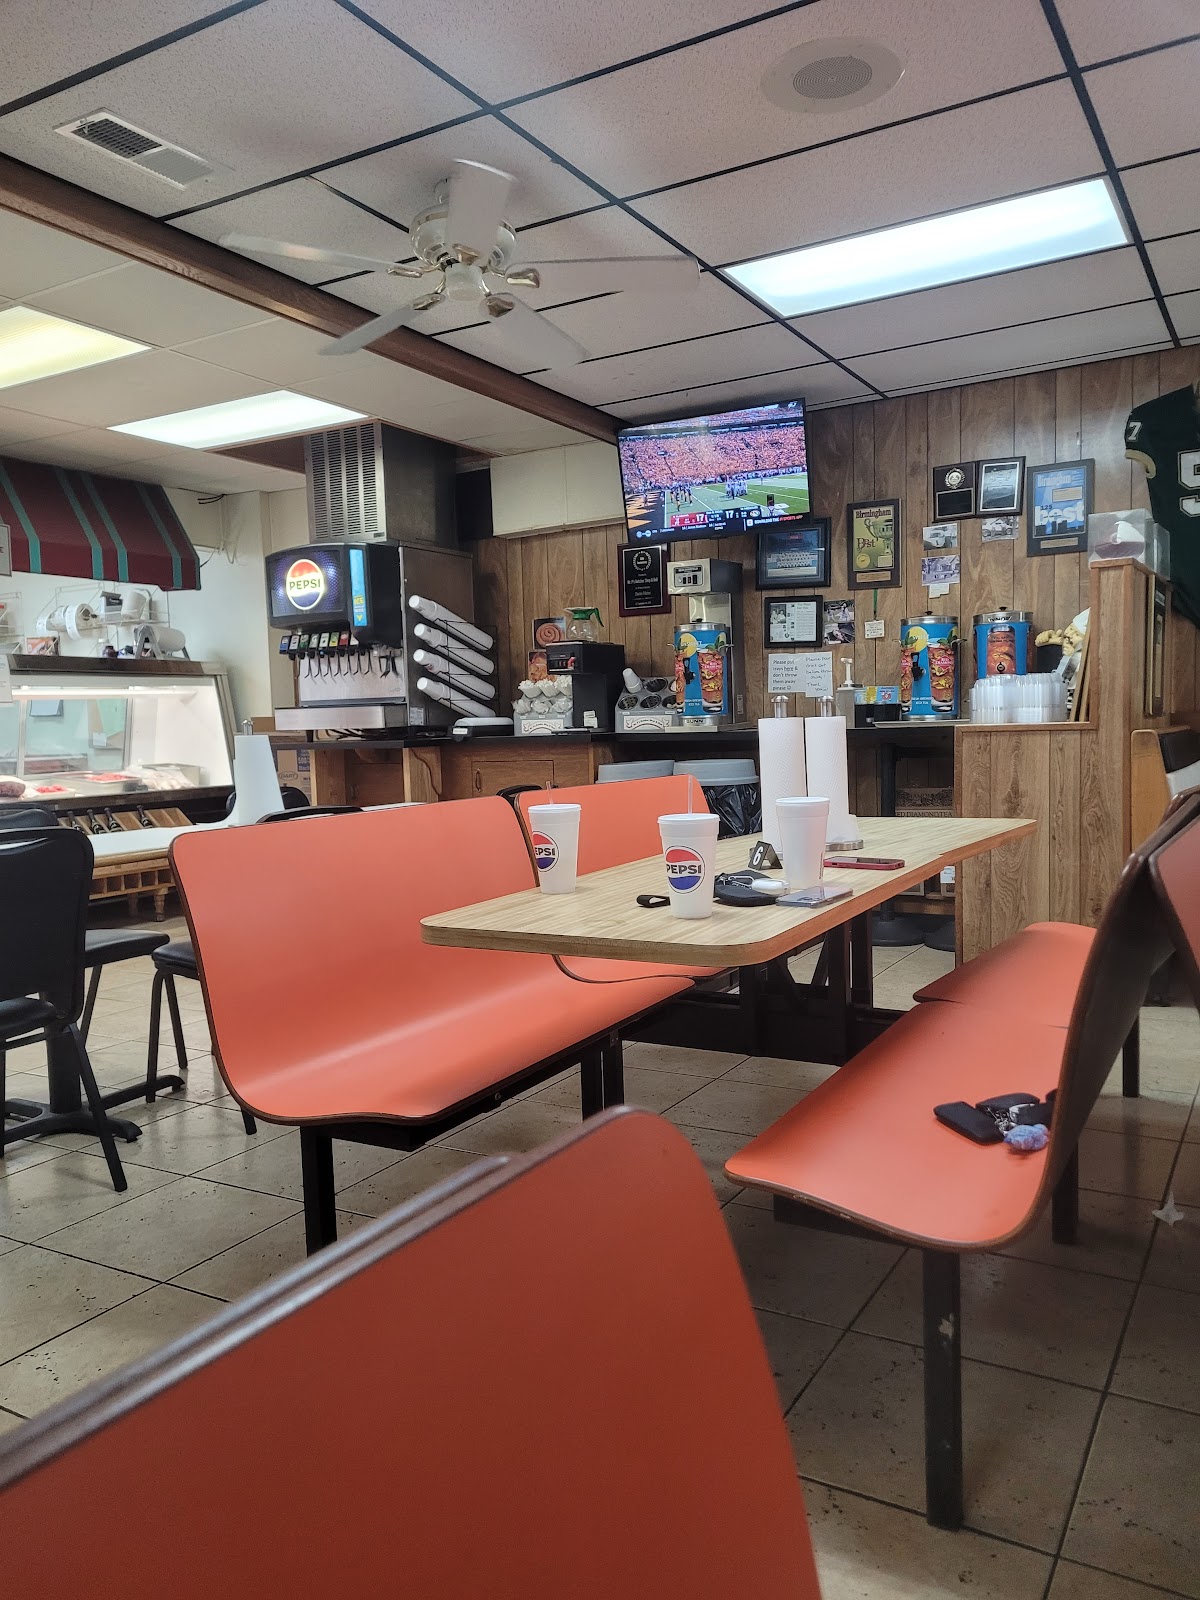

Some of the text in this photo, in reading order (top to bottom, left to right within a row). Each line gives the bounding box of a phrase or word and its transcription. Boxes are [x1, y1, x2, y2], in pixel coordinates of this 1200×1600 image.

[1127, 420, 1143, 442] 7
[695, 513, 704, 522] 17
[725, 510, 734, 519] 17
[855, 508, 892, 519] Birmingham
[1035, 501, 1085, 526] best
[289, 578, 321, 590] PEPSI
[534, 847, 556, 856] EPSI
[752, 845, 764, 866] 6
[666, 863, 702, 875] PEPSI
